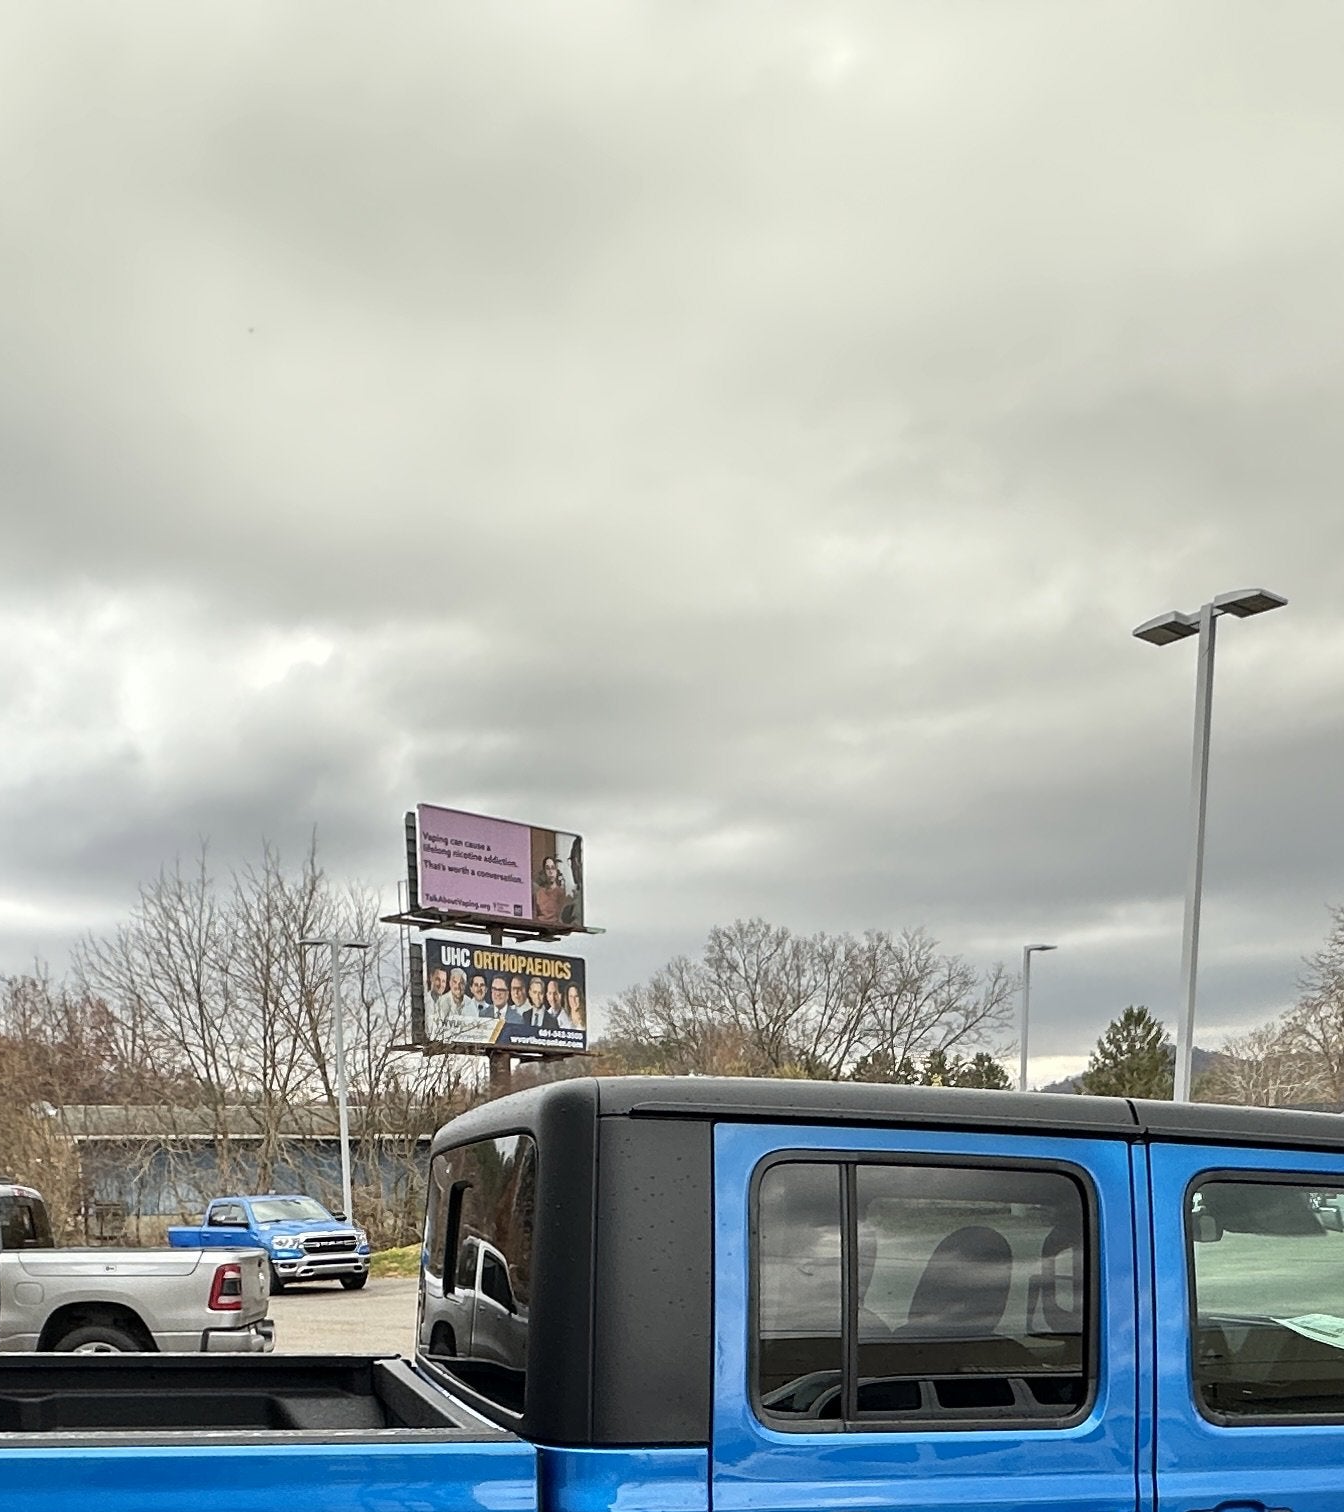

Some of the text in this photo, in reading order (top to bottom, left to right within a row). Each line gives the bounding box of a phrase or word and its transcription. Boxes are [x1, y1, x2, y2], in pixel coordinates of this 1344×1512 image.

[422, 831, 449, 846] Vaping
[450, 838, 464, 846] can
[464, 840, 486, 850] cause
[441, 945, 572, 980] UHC ORTHOPAEDICS
